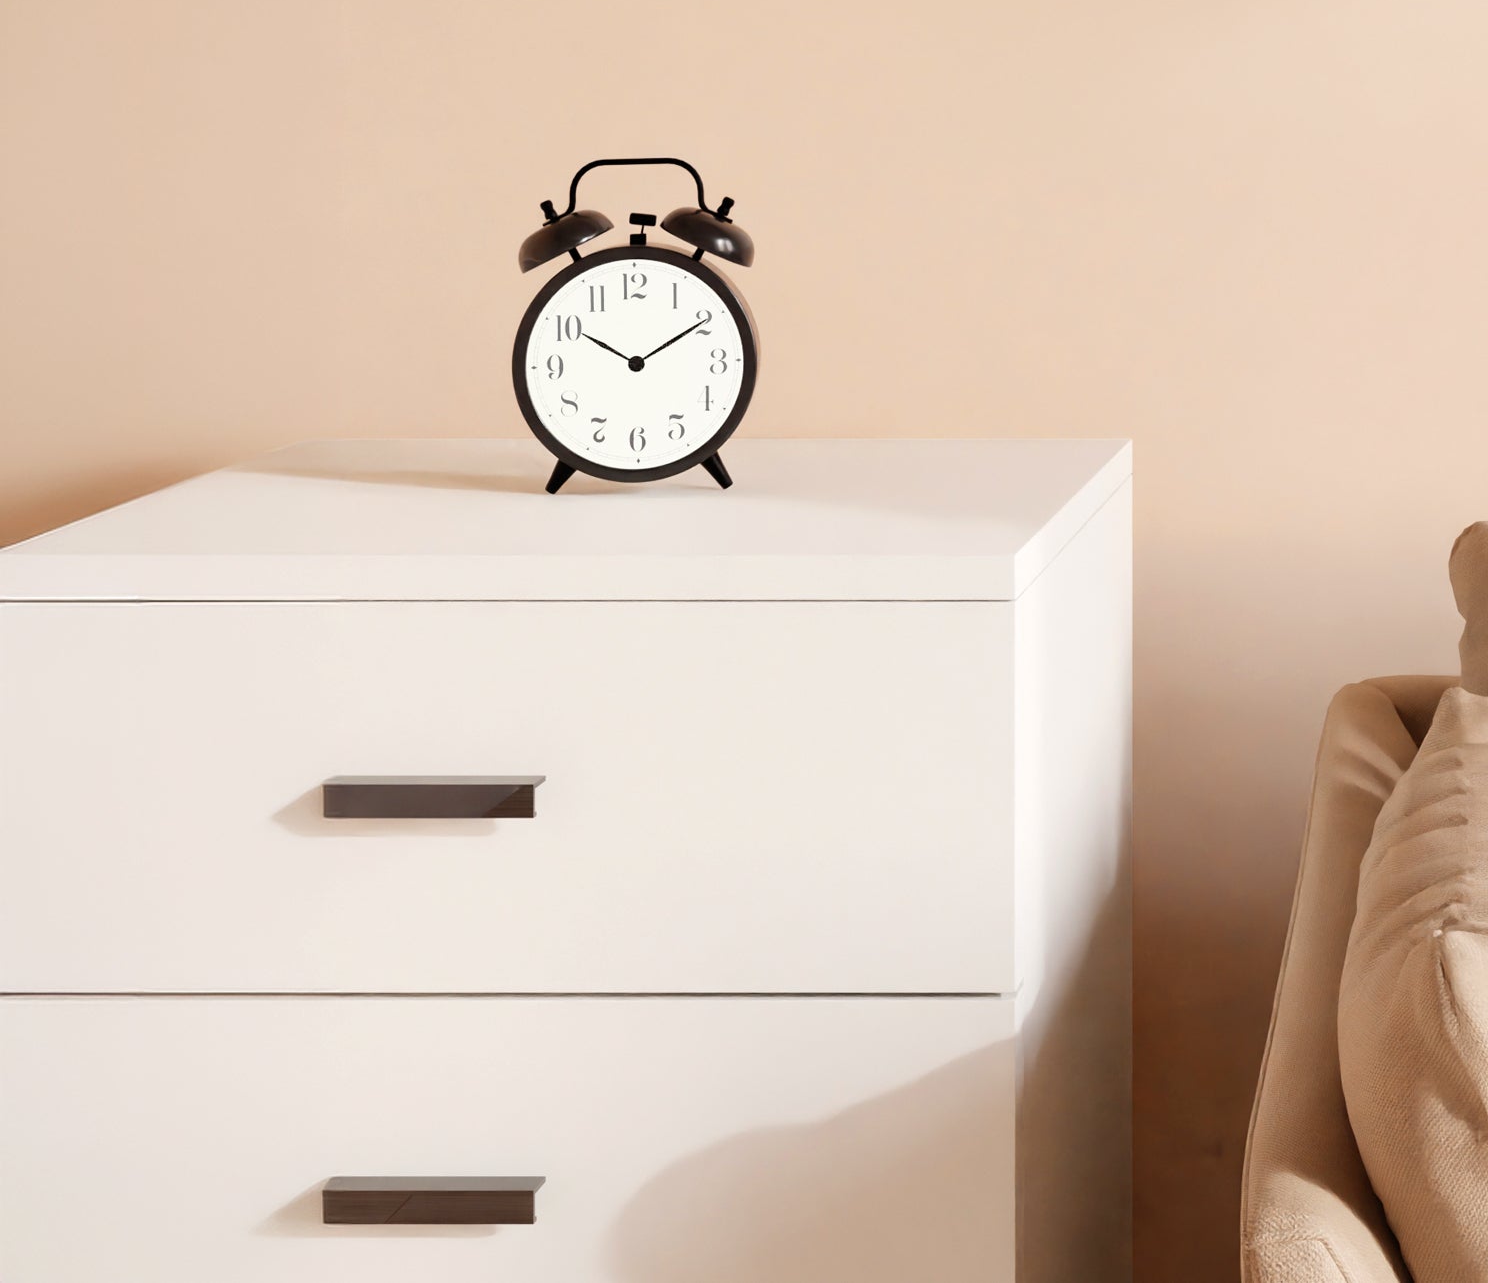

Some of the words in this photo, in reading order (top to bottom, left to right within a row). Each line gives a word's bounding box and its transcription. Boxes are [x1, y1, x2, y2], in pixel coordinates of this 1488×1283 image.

[589, 285, 606, 312] 11
[622, 273, 647, 300] 12
[672, 283, 679, 309] 1
[556, 315, 582, 342] 10
[695, 310, 713, 335] 2
[546, 354, 564, 380] 9
[709, 348, 728, 375] 3
[560, 390, 579, 417] 8
[697, 385, 714, 411] 4
[629, 426, 646, 452] 6
[668, 414, 685, 440] 5
